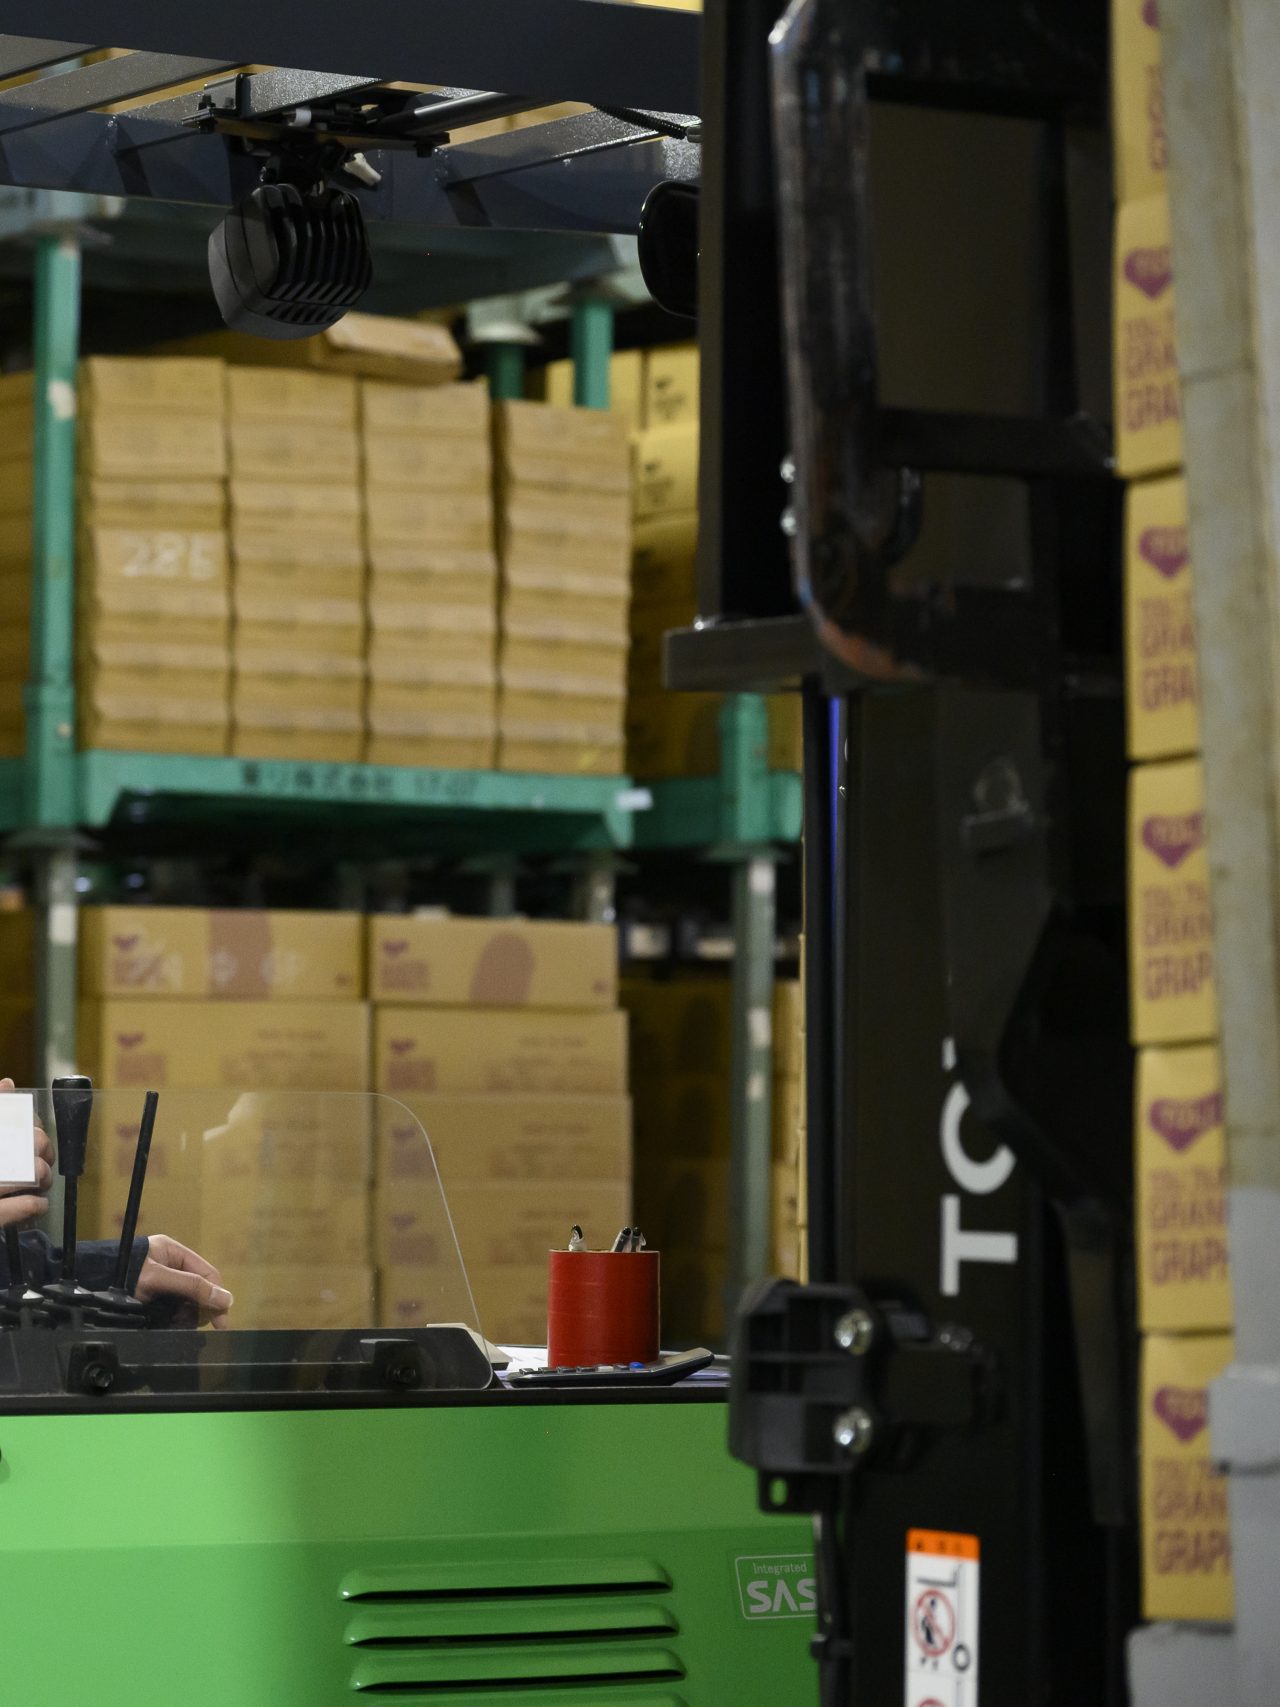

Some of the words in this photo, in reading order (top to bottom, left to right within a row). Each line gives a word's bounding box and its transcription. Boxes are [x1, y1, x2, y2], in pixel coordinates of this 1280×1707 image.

[939, 1036, 1018, 1297] TO
[752, 1561, 808, 1576] Integrated
[746, 1578, 817, 1613] SAS
